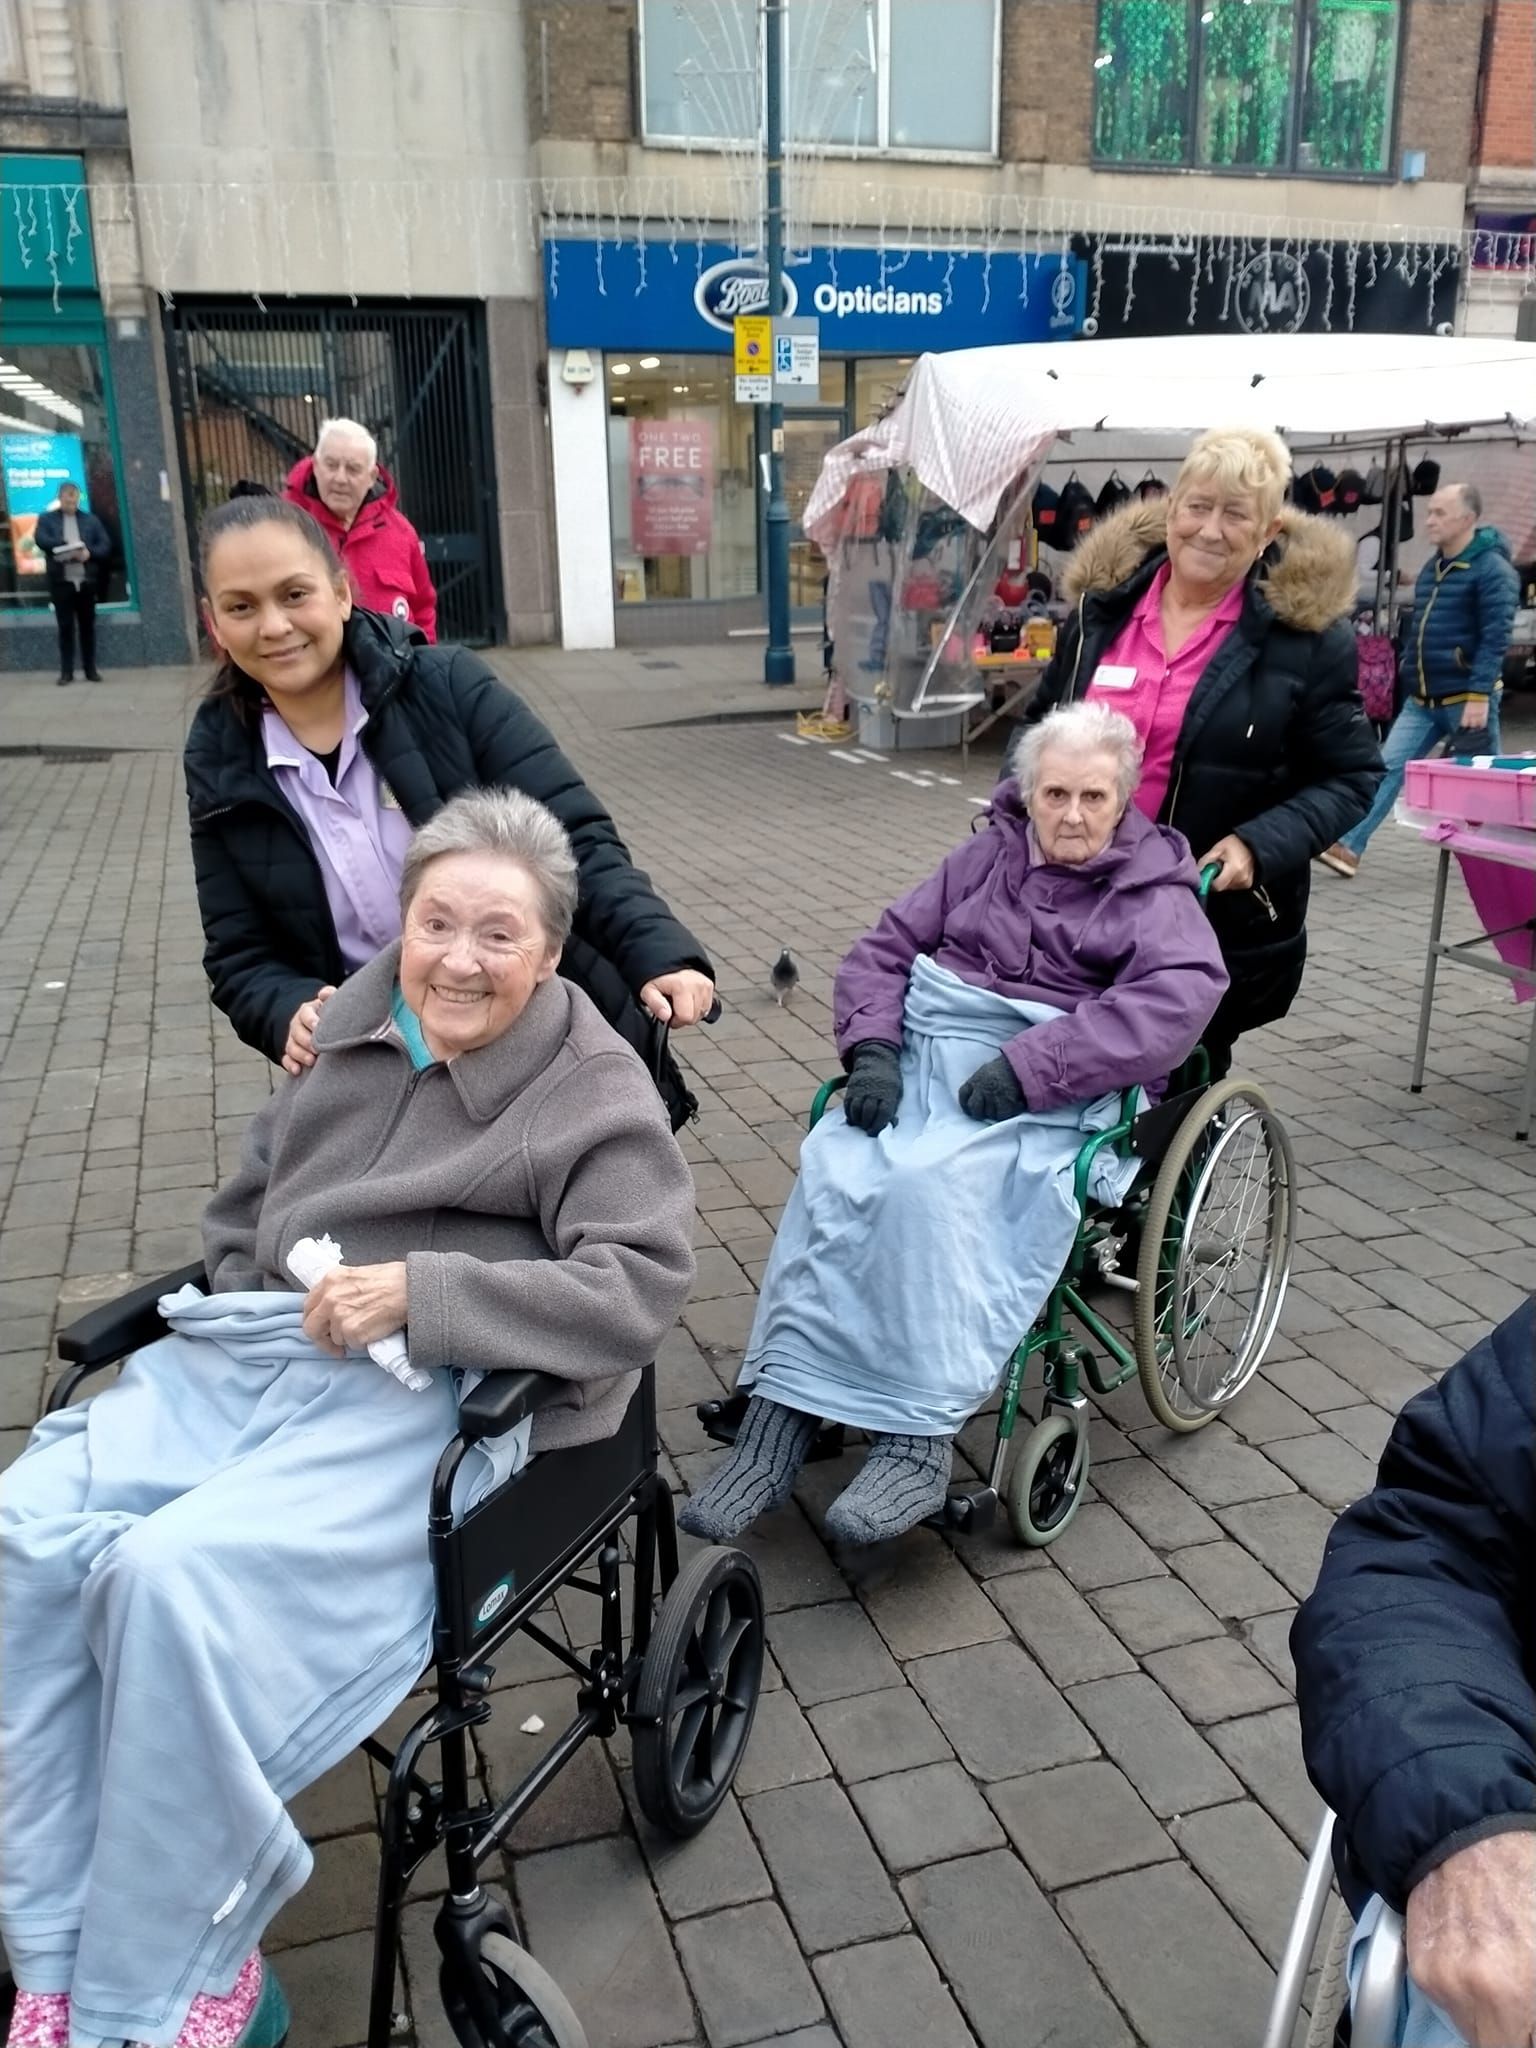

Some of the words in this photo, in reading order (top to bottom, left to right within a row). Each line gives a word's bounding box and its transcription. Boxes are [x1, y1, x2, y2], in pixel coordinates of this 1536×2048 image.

[713, 276, 770, 314] Boot
[813, 283, 943, 318] Opticians
[639, 446, 702, 469] FREE
